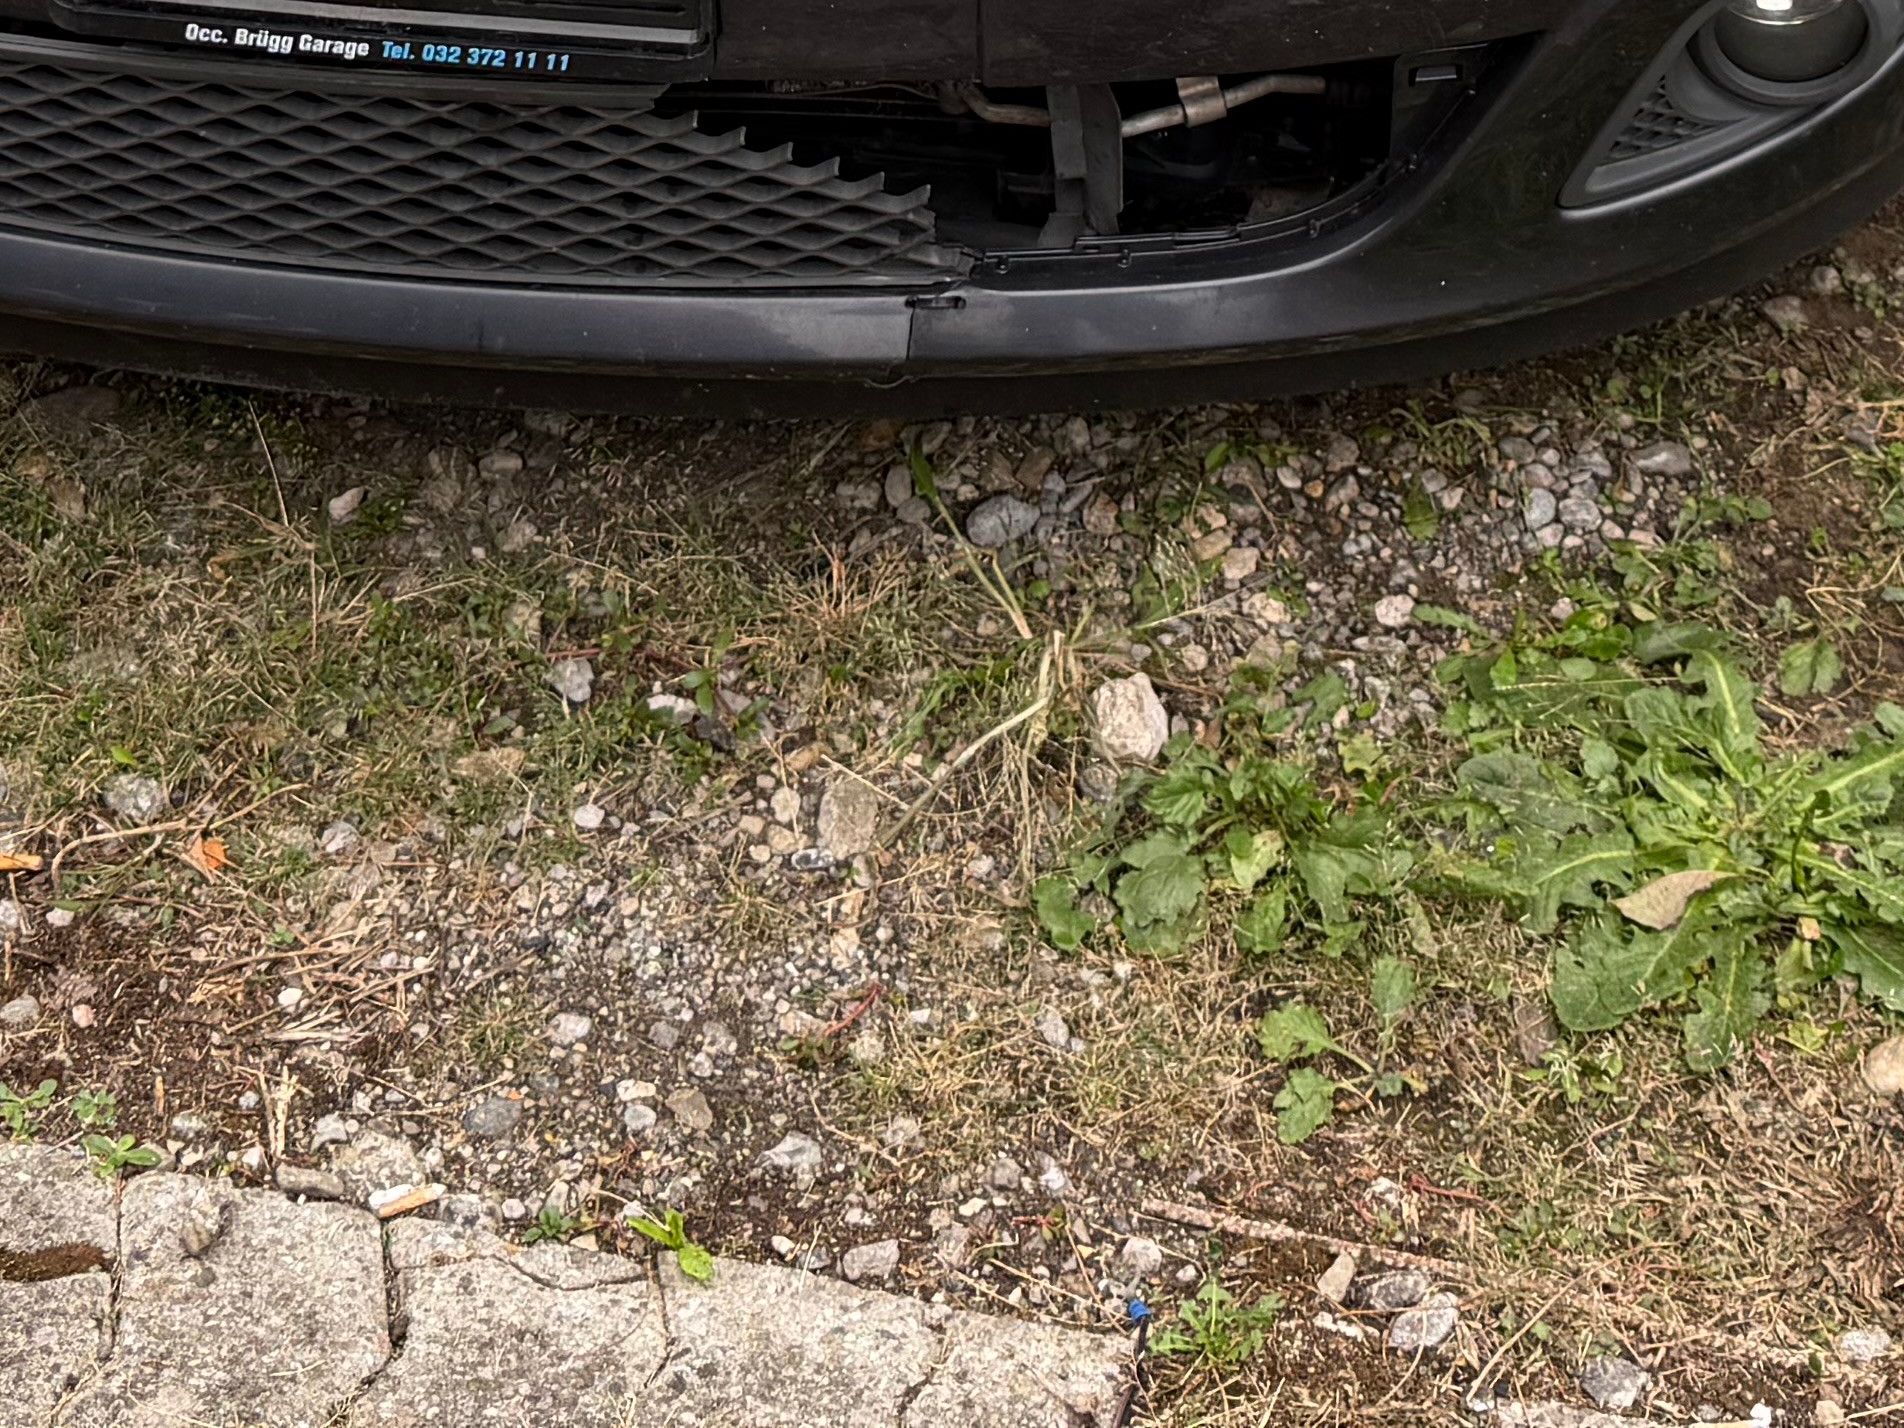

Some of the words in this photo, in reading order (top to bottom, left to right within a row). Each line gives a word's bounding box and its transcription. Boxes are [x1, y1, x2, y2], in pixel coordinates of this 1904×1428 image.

[184, 23, 229, 43] Occ.
[234, 28, 294, 54] Brügg
[298, 34, 370, 60] Garage
[382, 40, 415, 60] Tel.
[421, 44, 462, 64] 032
[466, 47, 506, 68] 372
[514, 50, 537, 69] 11
[547, 53, 570, 72] 11
